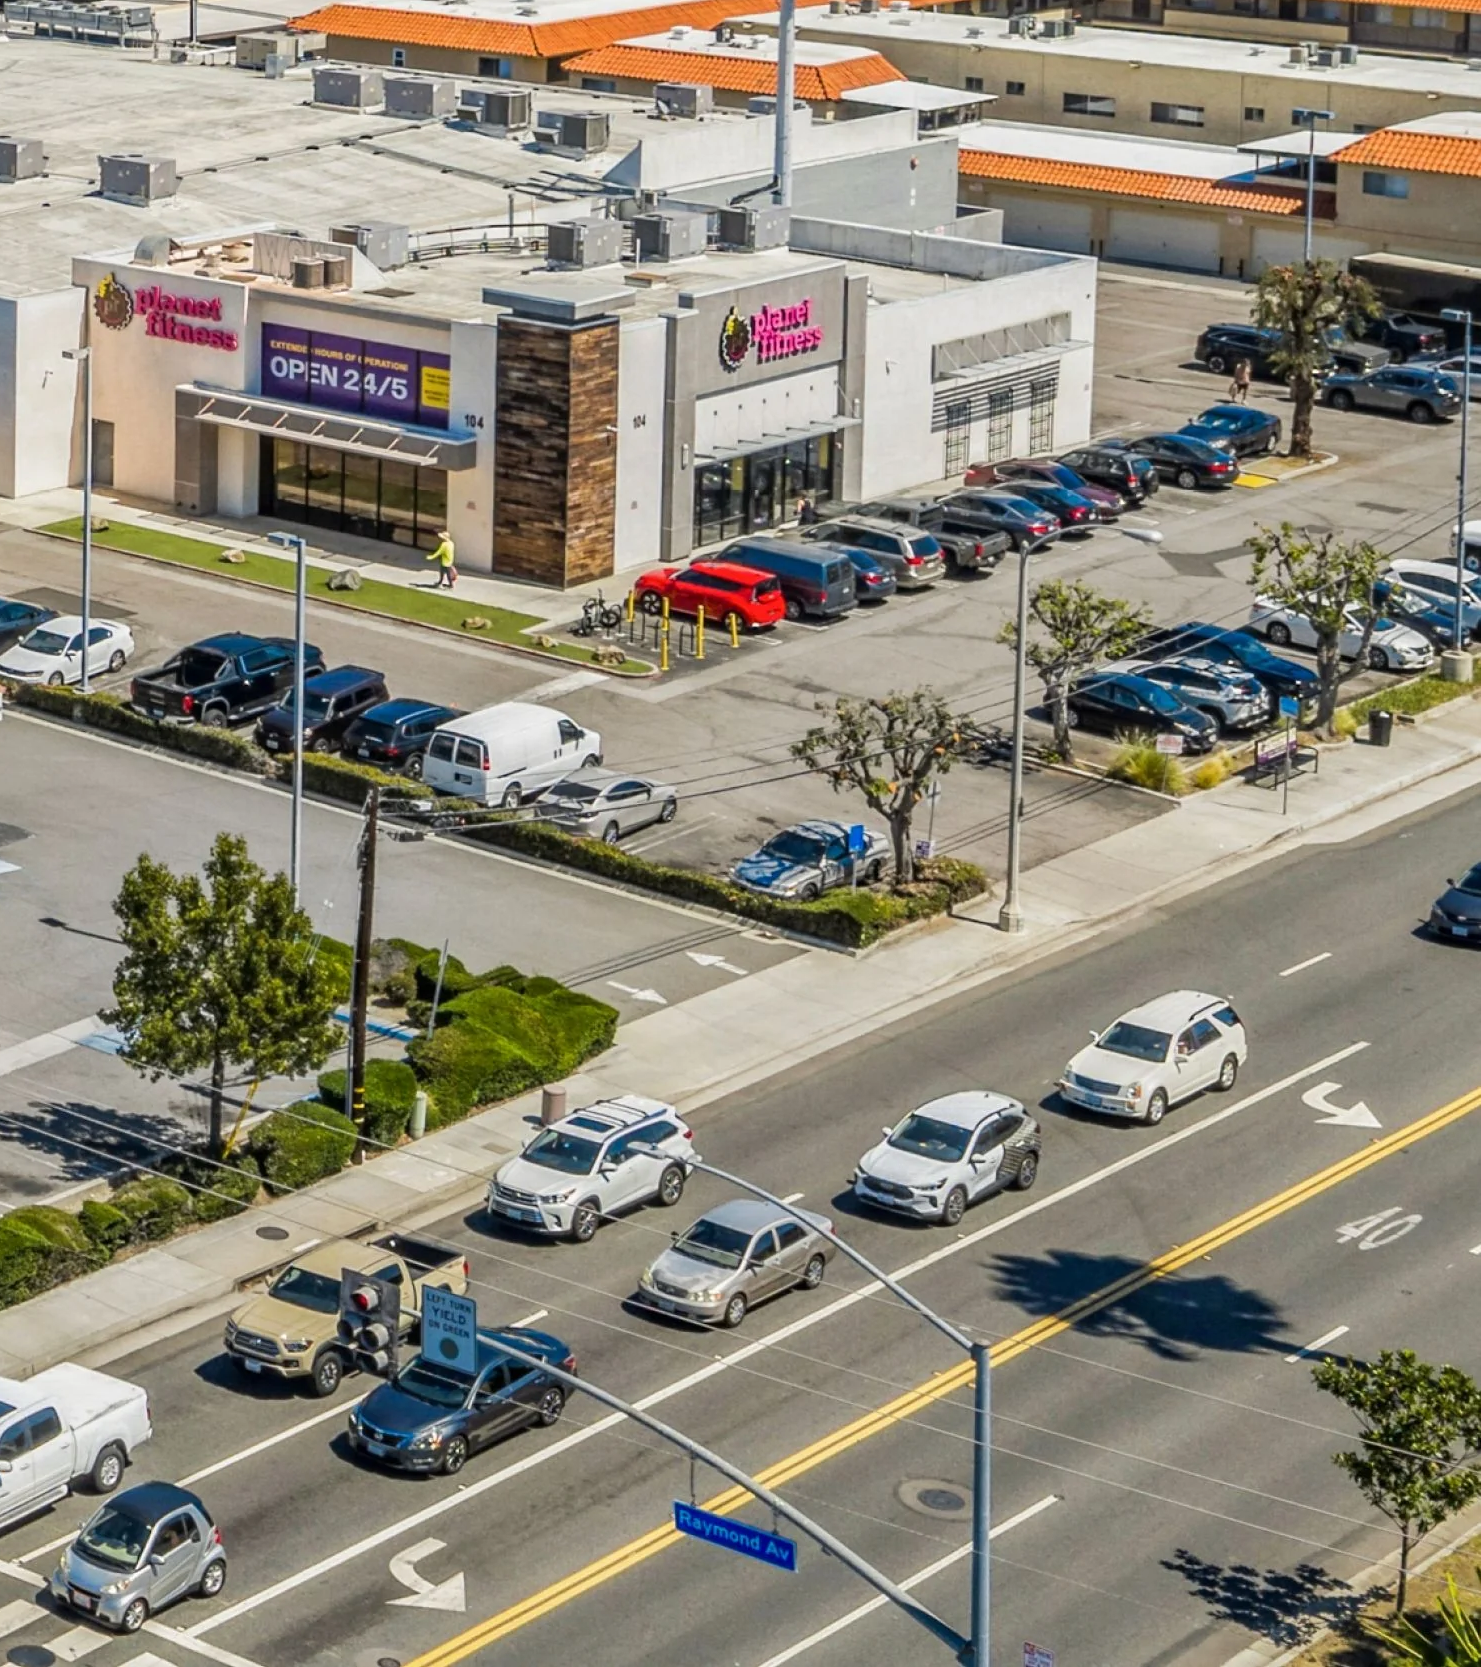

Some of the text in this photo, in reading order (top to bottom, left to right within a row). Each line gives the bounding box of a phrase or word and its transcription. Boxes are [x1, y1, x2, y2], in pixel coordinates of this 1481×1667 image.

[134, 286, 222, 321] planet
[754, 297, 813, 341] planet
[145, 311, 238, 352] fitness
[761, 324, 824, 358] fitness
[270, 339, 314, 356] EXTENDE
[315, 347, 344, 361] HOURS
[345, 352, 356, 362] OF
[270, 355, 338, 388] OPEN
[343, 368, 408, 401] 24/5
[464, 414, 484, 430] 104
[1335, 1206, 1423, 1250] 40
[427, 1293, 472, 1313] LEFT TURN
[432, 1305, 467, 1325] YIELD
[428, 1319, 470, 1339] ON GREEN
[678, 1509, 789, 1562] Raymond Av
